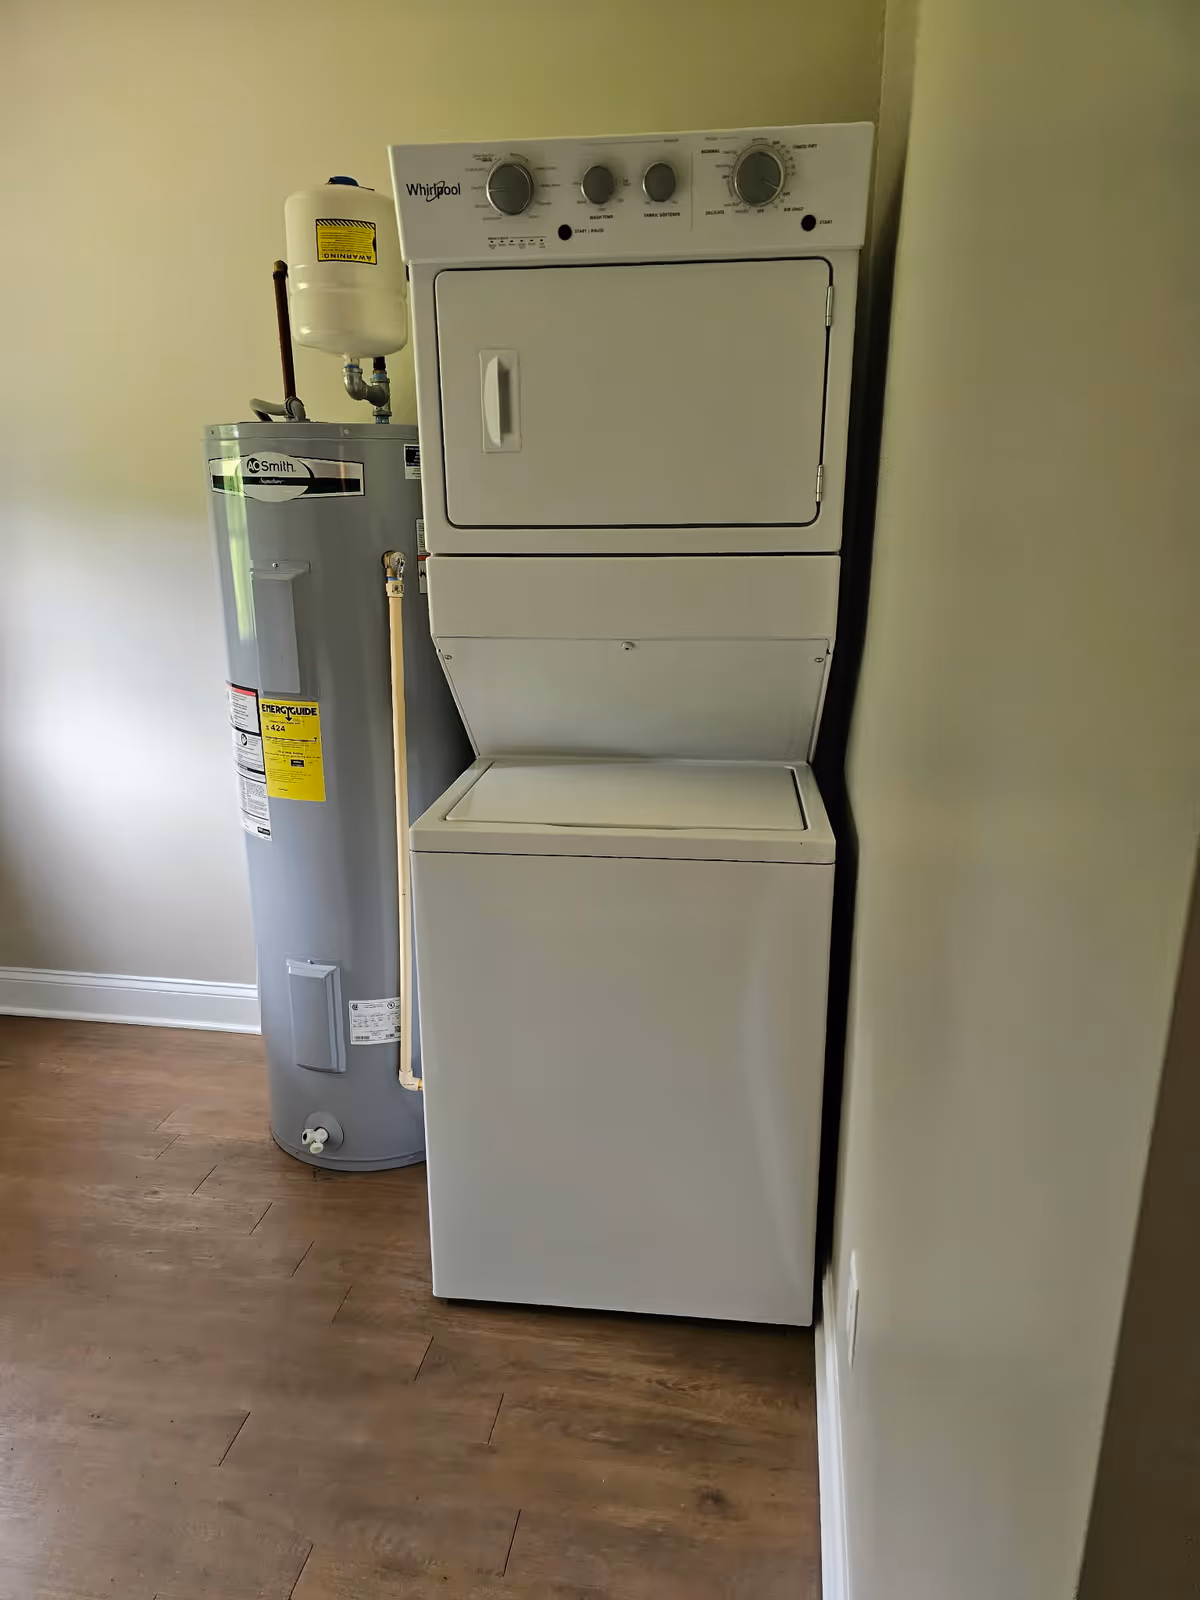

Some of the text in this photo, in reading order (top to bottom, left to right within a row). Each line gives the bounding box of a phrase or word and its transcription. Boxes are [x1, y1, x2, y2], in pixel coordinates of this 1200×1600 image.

[406, 181, 461, 202] Whirlpool
[261, 703, 317, 717] ENERGYGUIDE
[271, 724, 286, 732] 424
